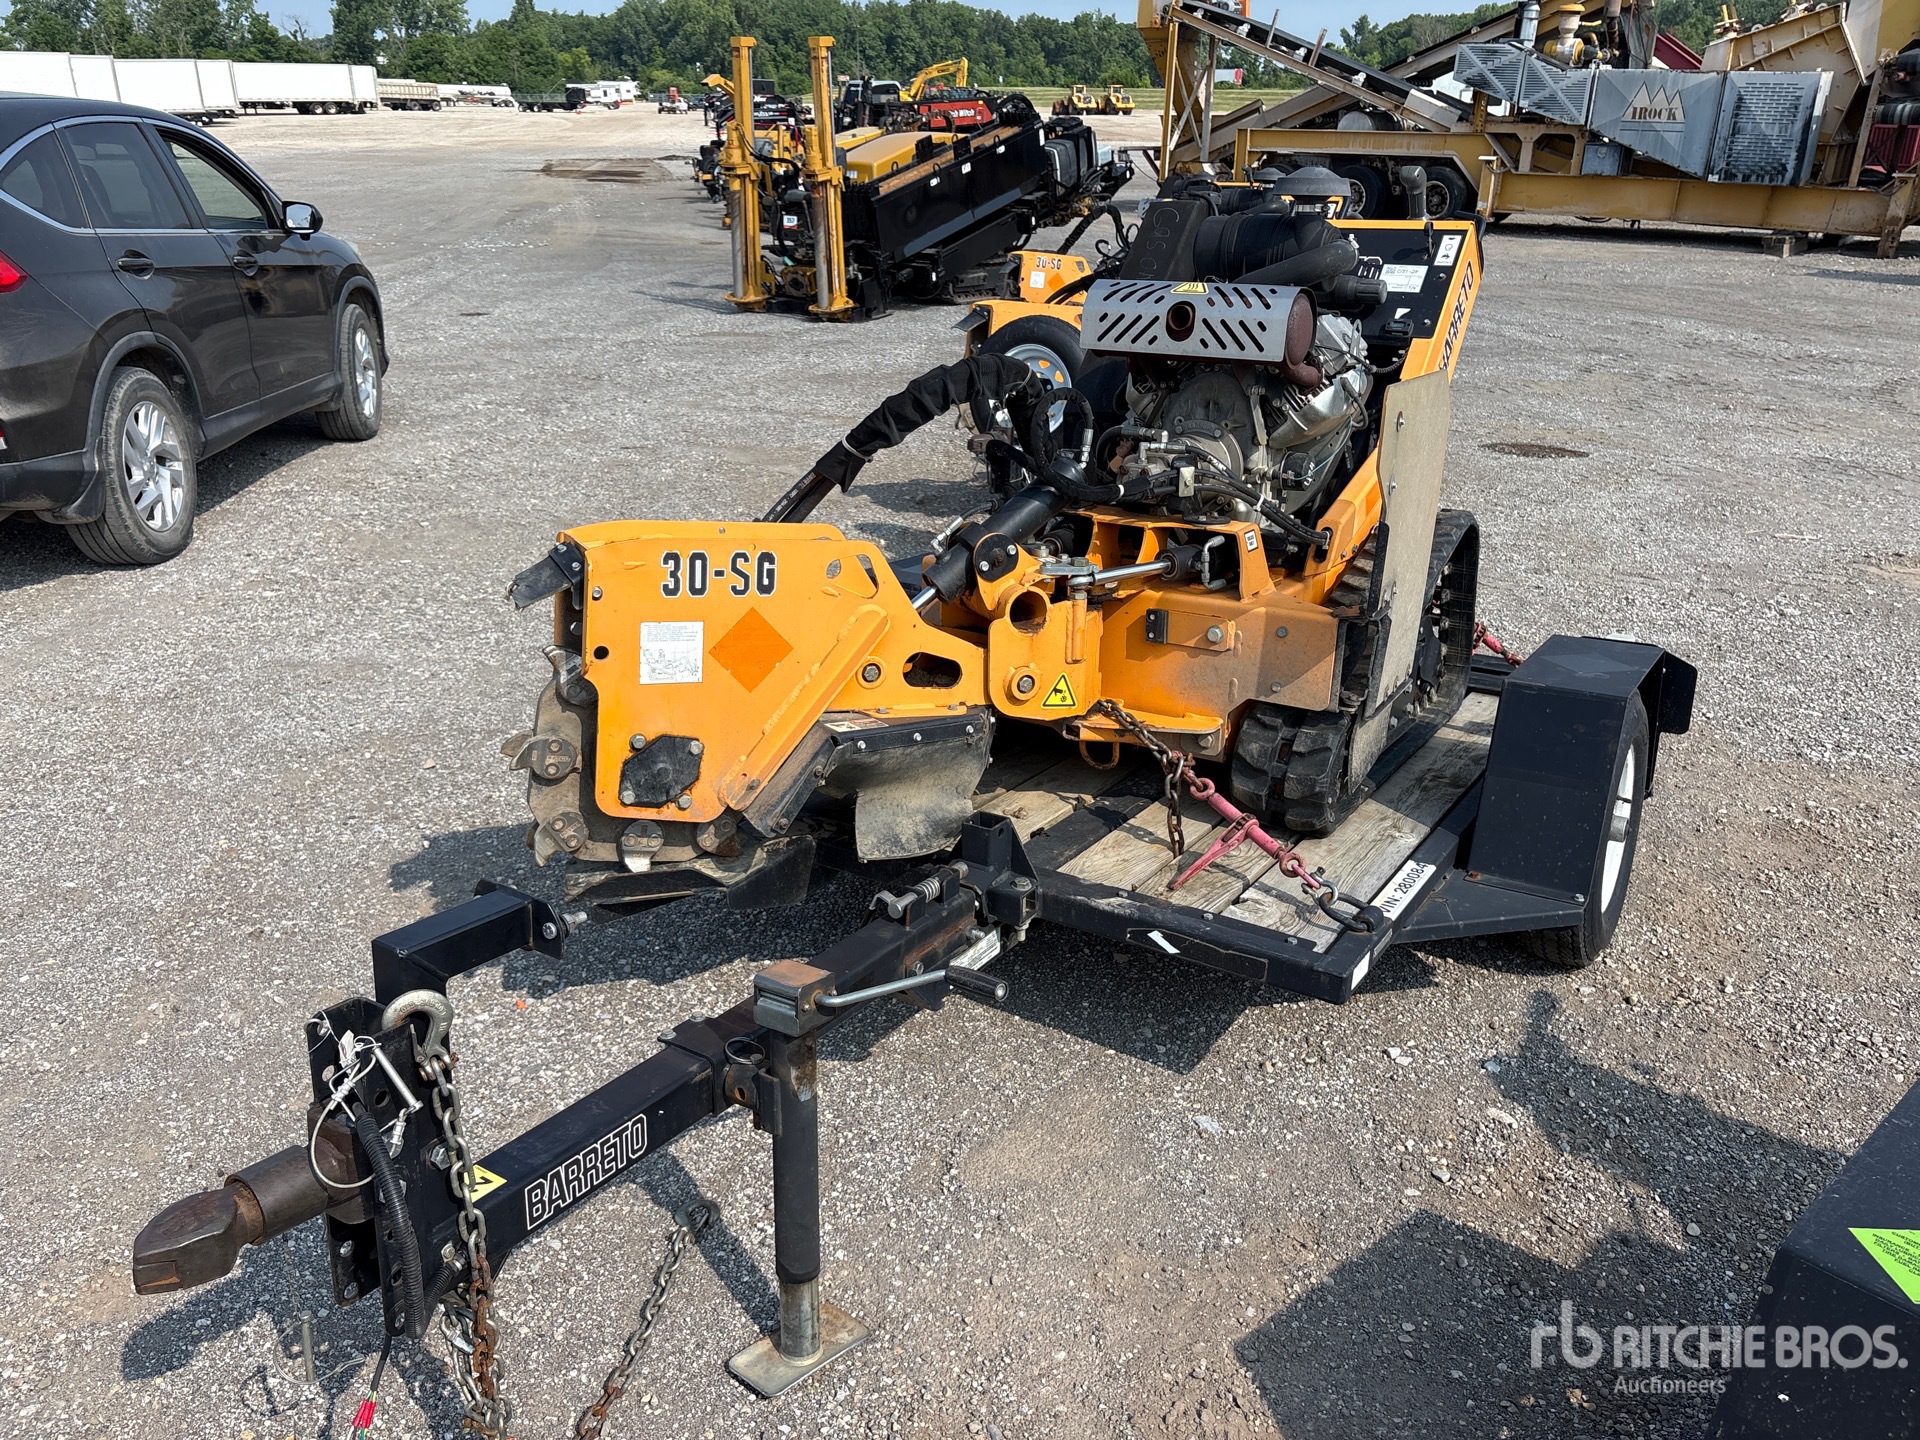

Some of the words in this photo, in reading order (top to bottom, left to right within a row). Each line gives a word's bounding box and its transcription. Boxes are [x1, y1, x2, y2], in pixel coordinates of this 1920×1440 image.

[1631, 106, 1678, 121] IROCK
[661, 551, 777, 598] 30-SG
[525, 1113, 648, 1231] BARRETO
